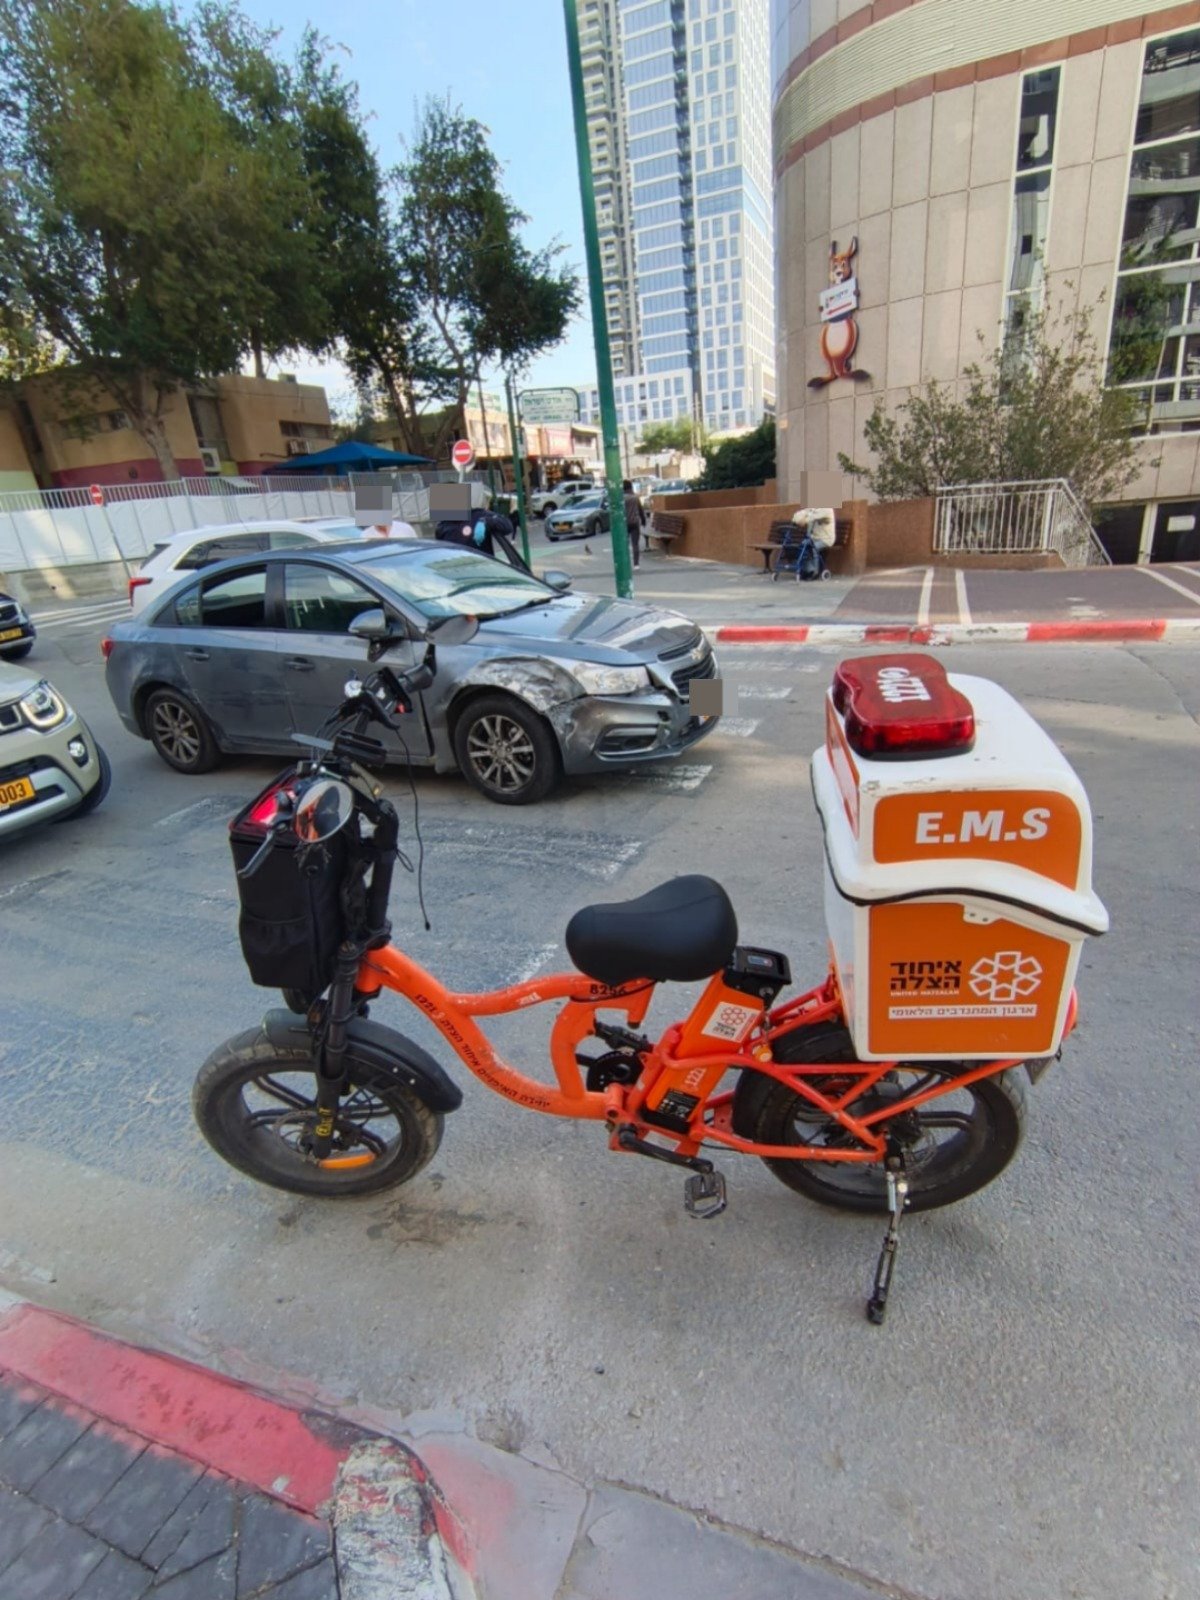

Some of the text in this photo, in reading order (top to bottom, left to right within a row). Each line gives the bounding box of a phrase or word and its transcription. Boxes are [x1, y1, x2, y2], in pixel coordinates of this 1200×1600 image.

[915, 807, 1051, 844] E.M.S
[890, 961, 962, 975] איחוד
[890, 975, 961, 990] הצלה
[891, 1006, 1034, 1017] ארגון המתנדבים הלאומי
[441, 1018, 463, 1043] הצלה
[463, 1043, 481, 1066] איחוד
